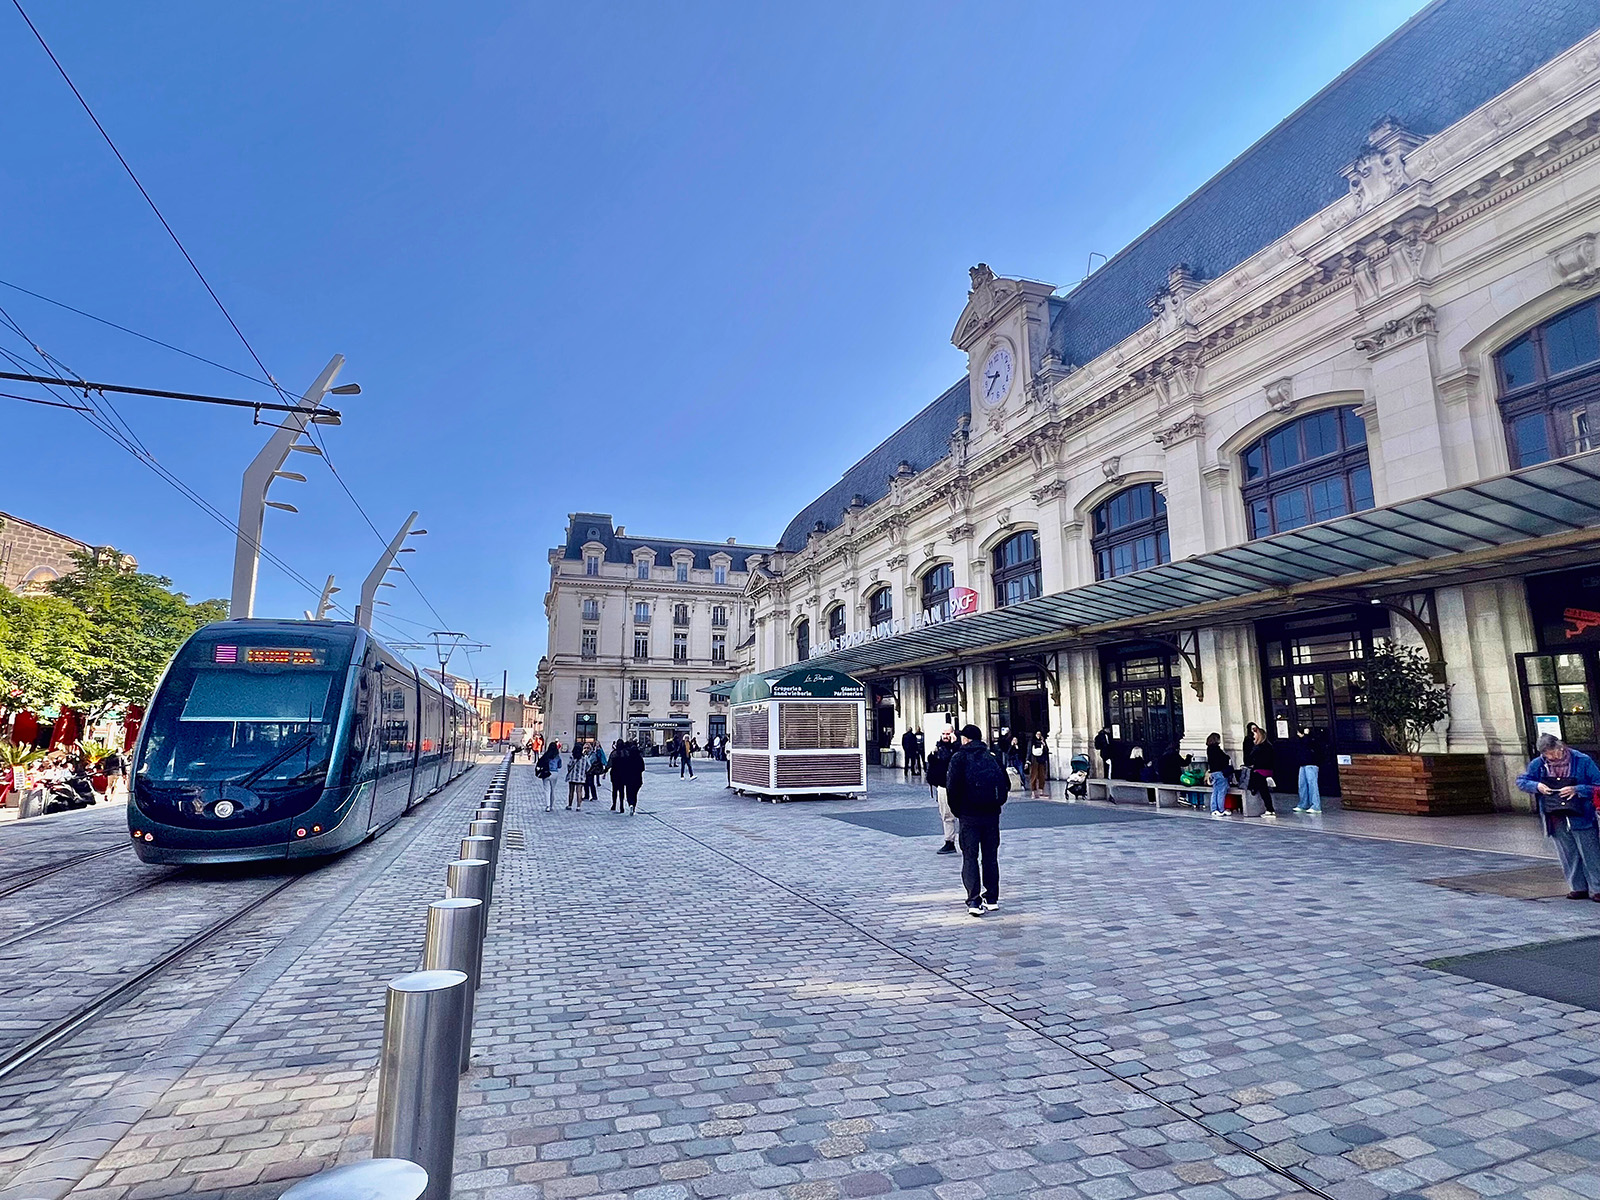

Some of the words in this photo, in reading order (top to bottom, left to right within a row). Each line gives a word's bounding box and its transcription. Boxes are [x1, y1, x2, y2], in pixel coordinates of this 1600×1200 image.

[950, 593, 975, 613] SNCF
[829, 637, 840, 652] DE
[840, 620, 892, 650] BORDEAUX
